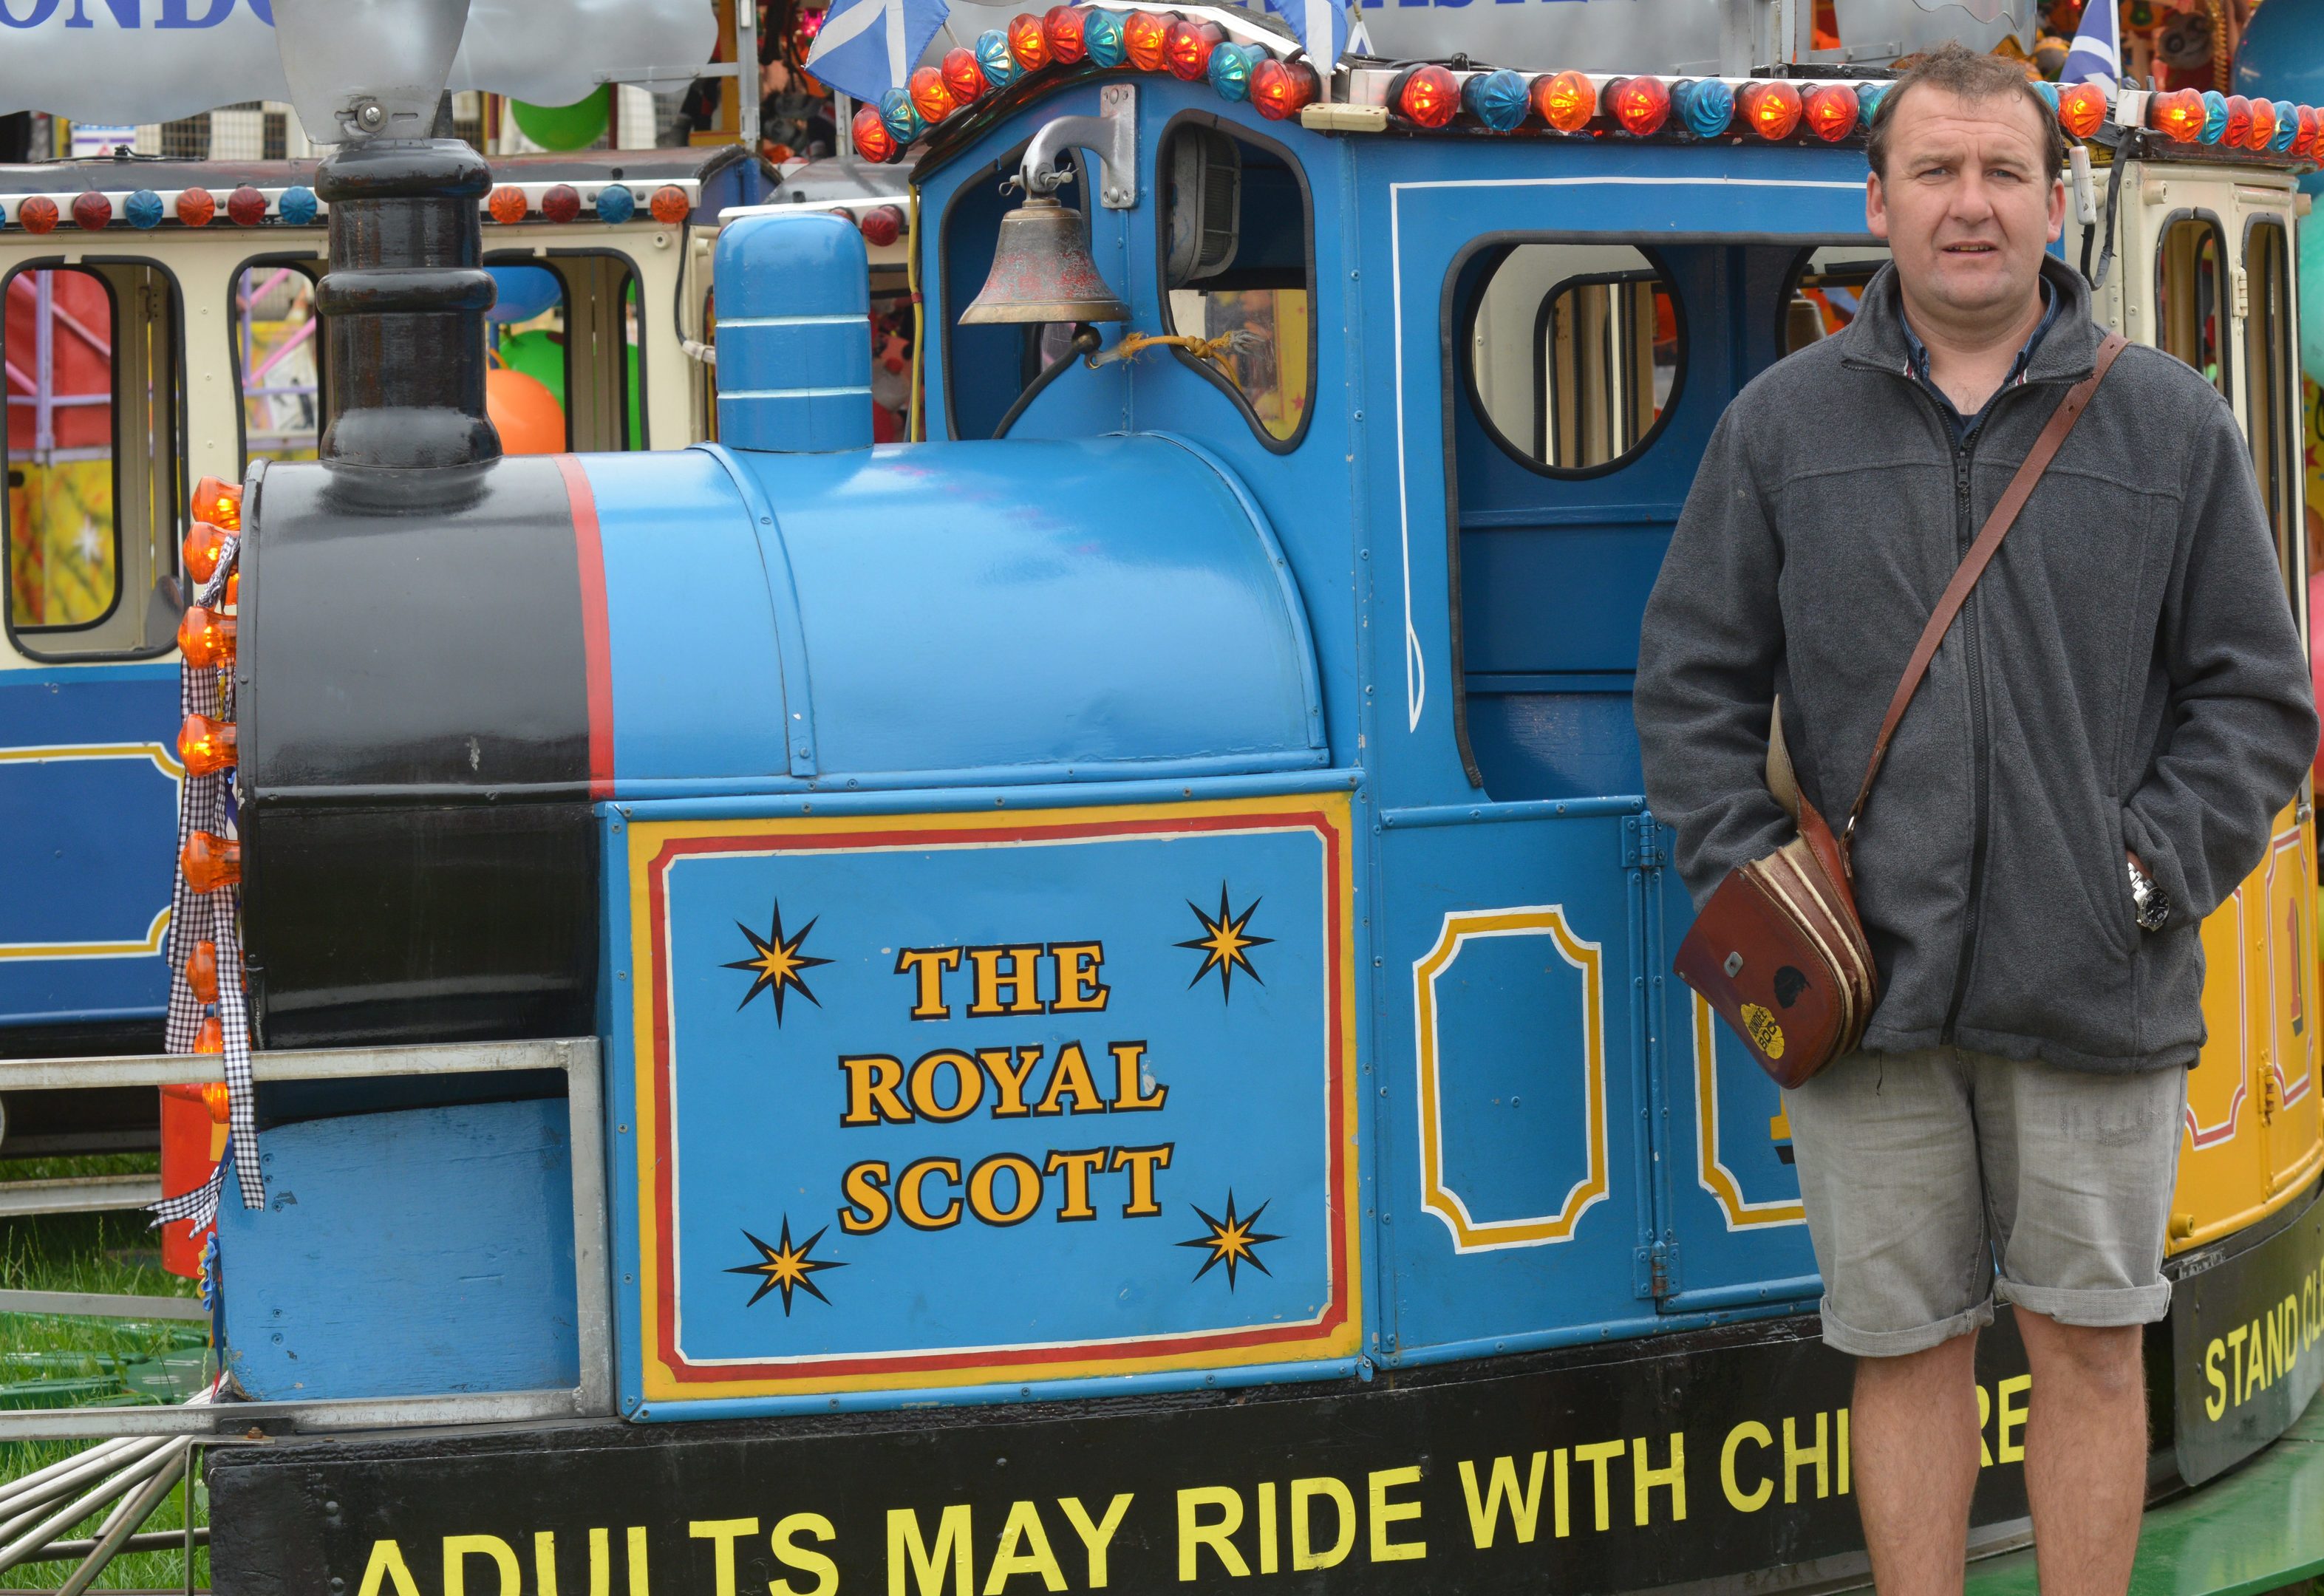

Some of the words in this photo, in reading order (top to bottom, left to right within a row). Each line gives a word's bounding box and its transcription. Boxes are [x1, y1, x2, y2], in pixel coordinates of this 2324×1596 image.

[893, 940, 1111, 1021] THE
[1748, 1007, 1767, 1037] DUNDEE
[838, 1040, 1170, 1128] ROYAL
[837, 1142, 1175, 1235] SCOTT
[2205, 1294, 2297, 1422] STAND
[887, 1493, 1134, 1596] MAY
[1176, 1465, 1426, 1581] RIDE
[1458, 1432, 1687, 1549] WITH
